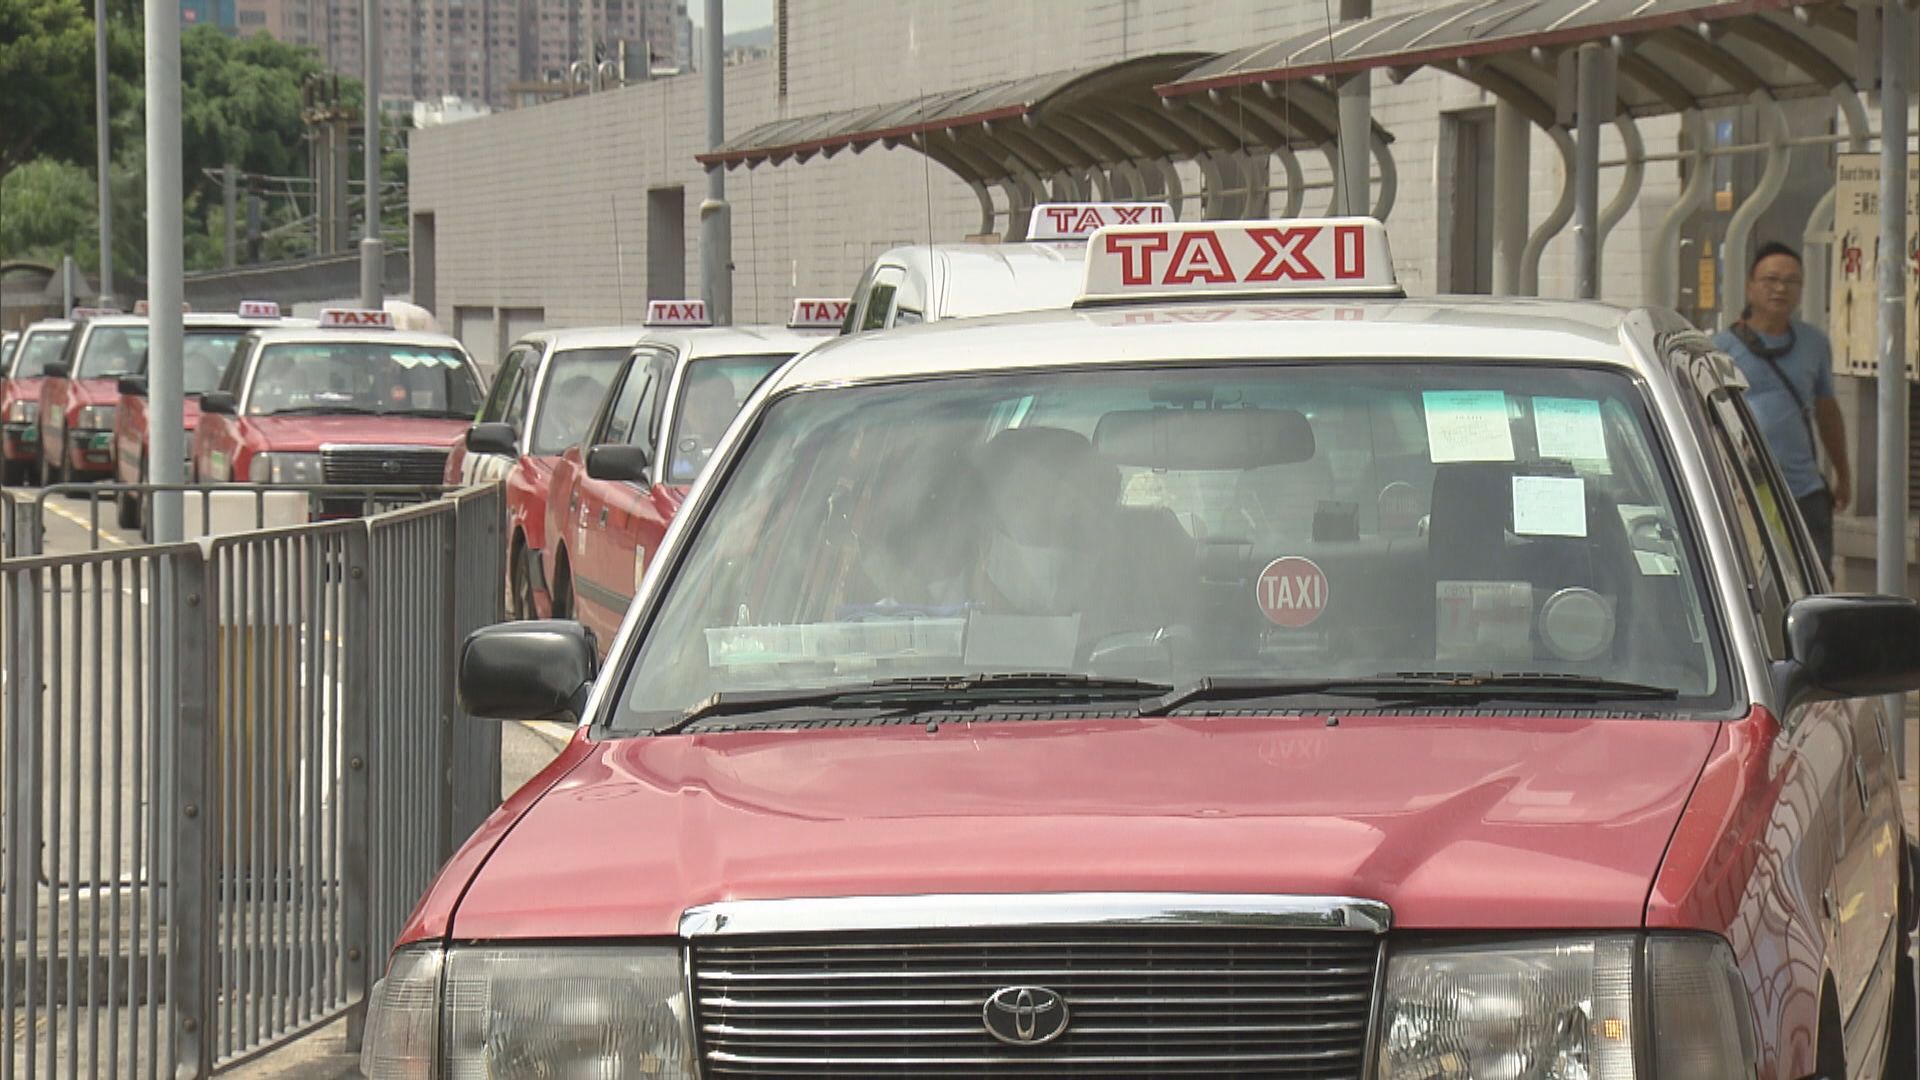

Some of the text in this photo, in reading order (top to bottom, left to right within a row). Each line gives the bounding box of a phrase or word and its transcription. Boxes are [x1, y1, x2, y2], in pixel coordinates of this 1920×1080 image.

[1047, 206, 1163, 233] TAXI
[1106, 225, 1365, 286] TAXI
[245, 304, 277, 315] TAXI
[328, 311, 386, 324] TAXI
[654, 304, 703, 319] TAXI
[800, 302, 848, 320] TAX
[1263, 575, 1321, 609] TAXI
